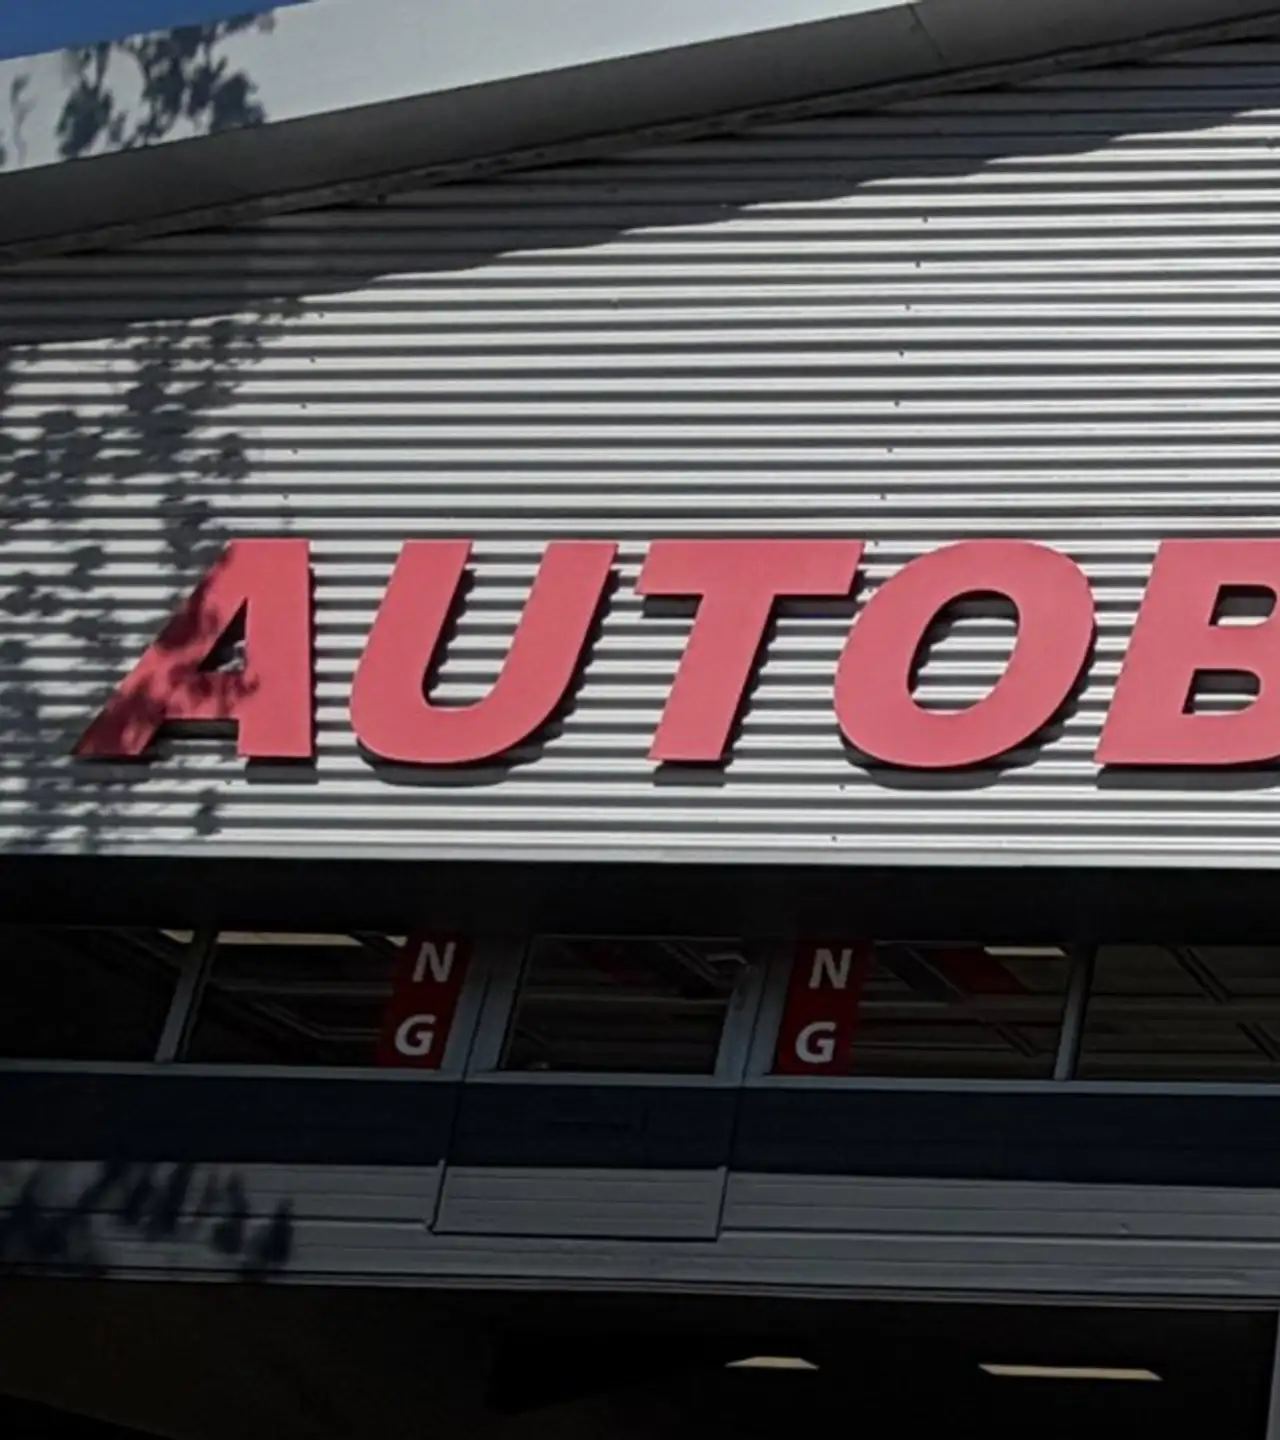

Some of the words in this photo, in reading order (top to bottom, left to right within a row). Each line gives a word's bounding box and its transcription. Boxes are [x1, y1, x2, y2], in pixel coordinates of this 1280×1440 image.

[411, 941, 456, 983] N
[808, 948, 852, 989] N
[395, 1014, 436, 1056] G
[795, 1021, 837, 1064] G
